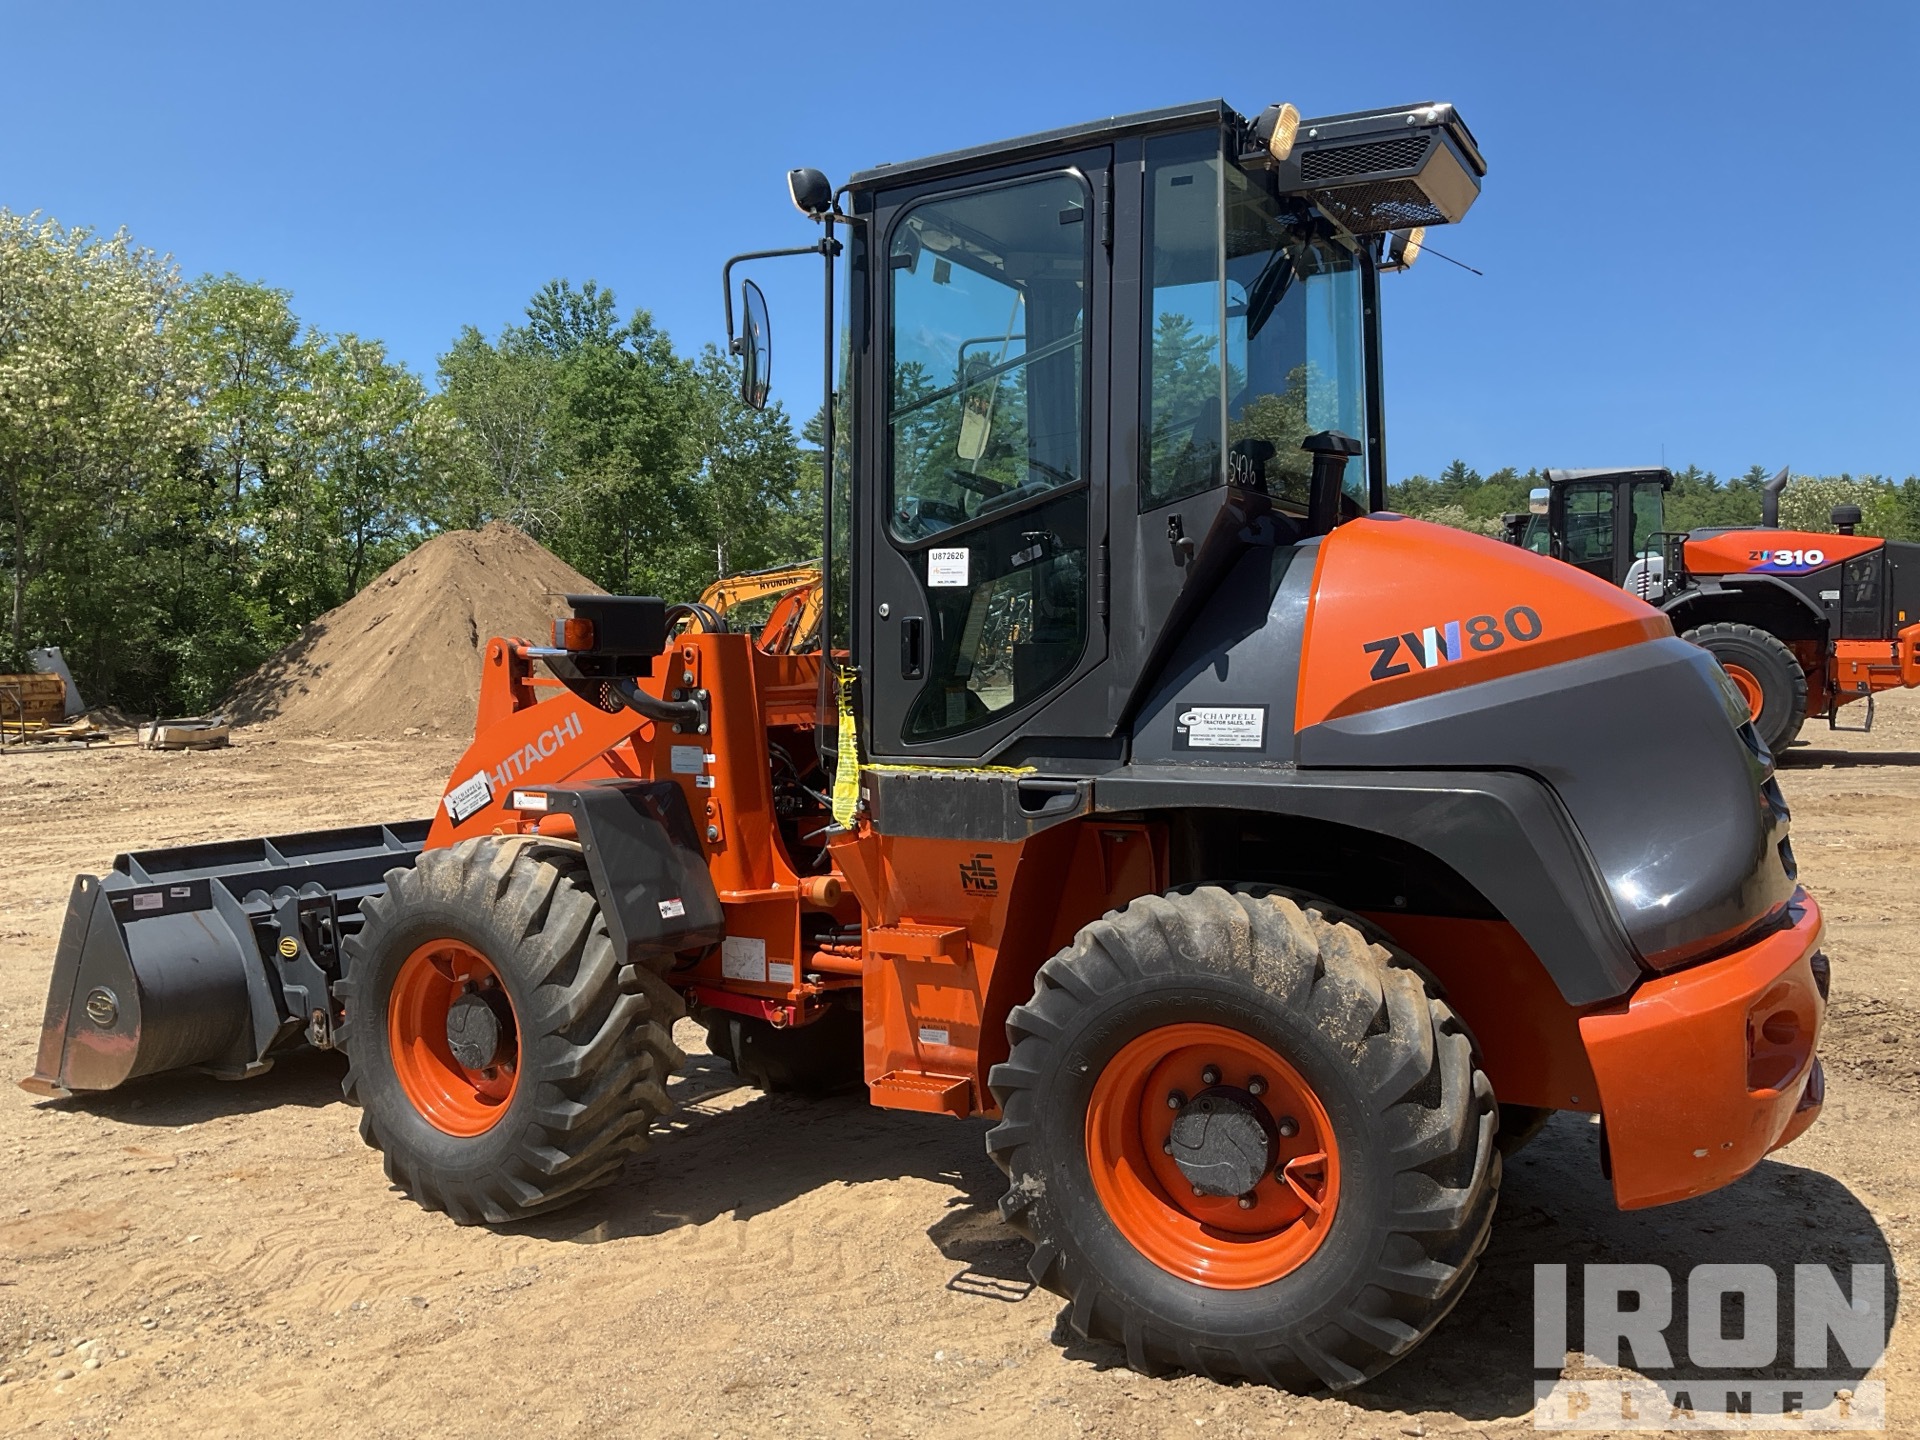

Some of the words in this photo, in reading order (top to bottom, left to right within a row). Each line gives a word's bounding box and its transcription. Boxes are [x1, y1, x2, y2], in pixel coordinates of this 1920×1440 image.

[1229, 450, 1256, 485] 5426
[932, 552, 964, 560] U872626
[1749, 549, 1824, 566] ZW310
[1363, 605, 1543, 681] ZW80
[1203, 713, 1257, 721] CHAPPELL
[485, 711, 583, 795] HITACHI
